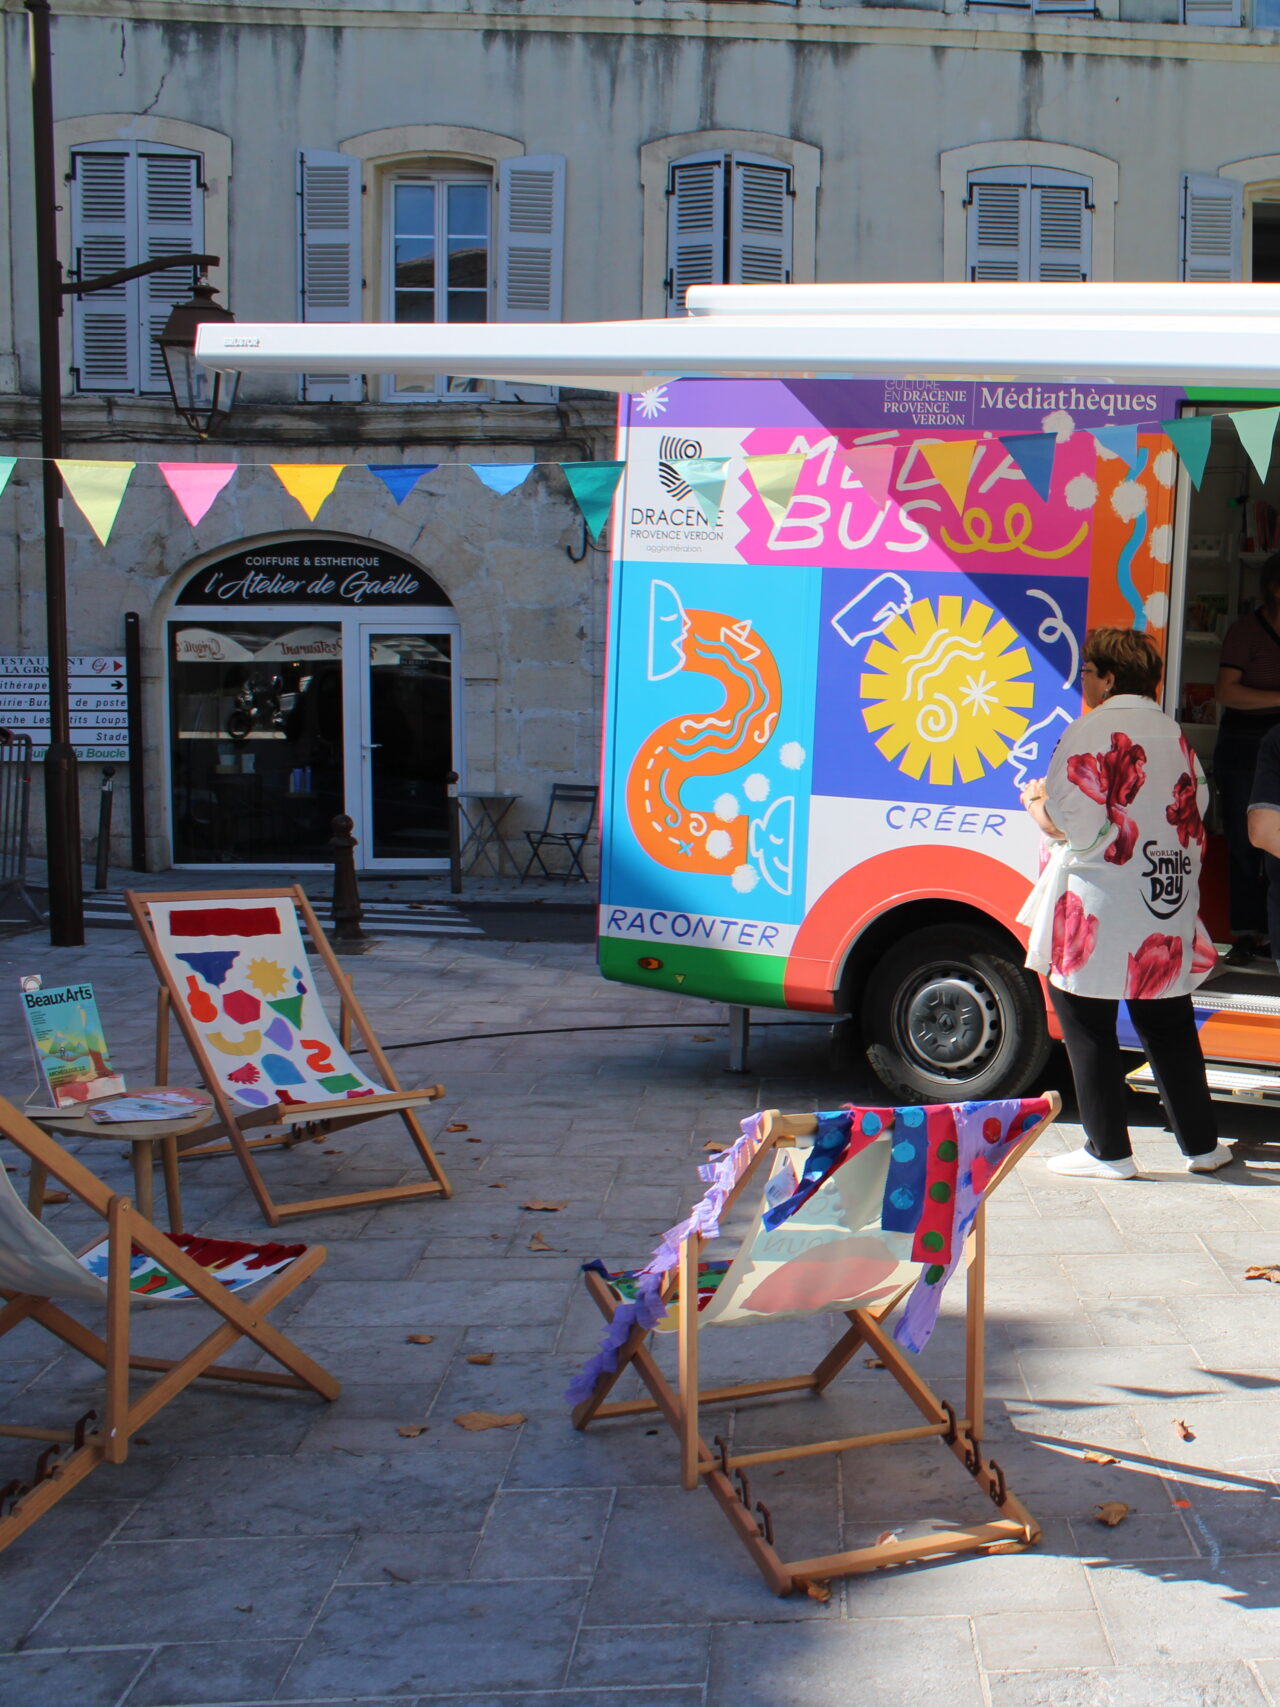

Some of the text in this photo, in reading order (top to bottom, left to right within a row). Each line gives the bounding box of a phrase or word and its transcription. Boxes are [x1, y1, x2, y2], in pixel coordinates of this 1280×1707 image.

[980, 386, 1158, 416] Médiathèques
[883, 402, 950, 414] PROVENCE
[912, 414, 966, 426] VERDON
[766, 494, 942, 553] BUS
[630, 529, 724, 541] PROVENCE VERDON
[245, 556, 380, 568] COIFFURE & ESTHETIQUE
[307, 573, 336, 595] de
[339, 570, 421, 603] Gaëlle
[75, 697, 88, 708] de
[96, 698, 126, 709] poste
[96, 715, 127, 726] Loups
[96, 731, 128, 741] Stade
[86, 748, 127, 759] Boucle
[885, 804, 1007, 837] CRÉER
[1141, 840, 1192, 878] Smile
[1149, 849, 1176, 857] WORLD
[607, 908, 780, 950] RACONTER
